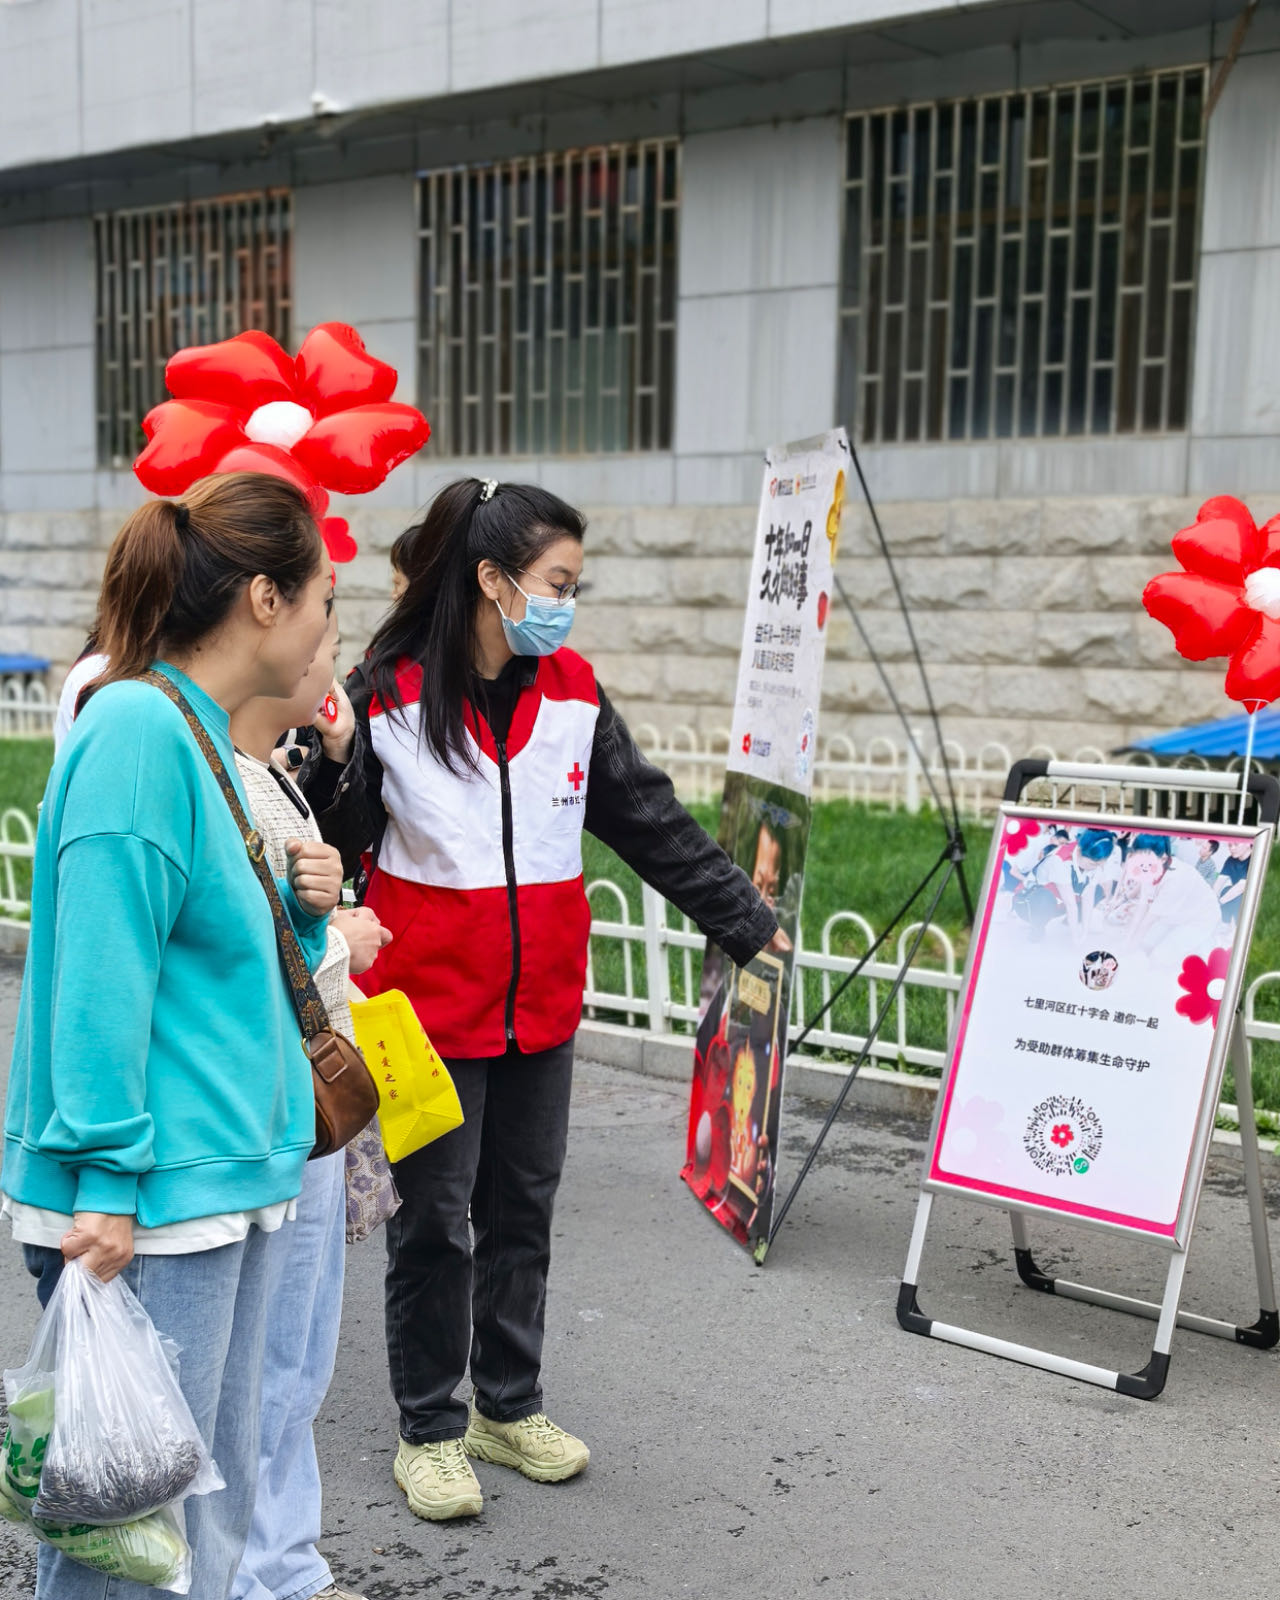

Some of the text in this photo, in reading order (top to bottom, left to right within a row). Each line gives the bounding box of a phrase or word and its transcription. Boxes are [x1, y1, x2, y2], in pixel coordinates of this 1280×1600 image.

[765, 520, 812, 566] 十年如一日
[1024, 996, 1159, 1029] 七里河区红十字会 邀你一起
[1014, 1037, 1151, 1073] 为受助群体筹集生命守护
